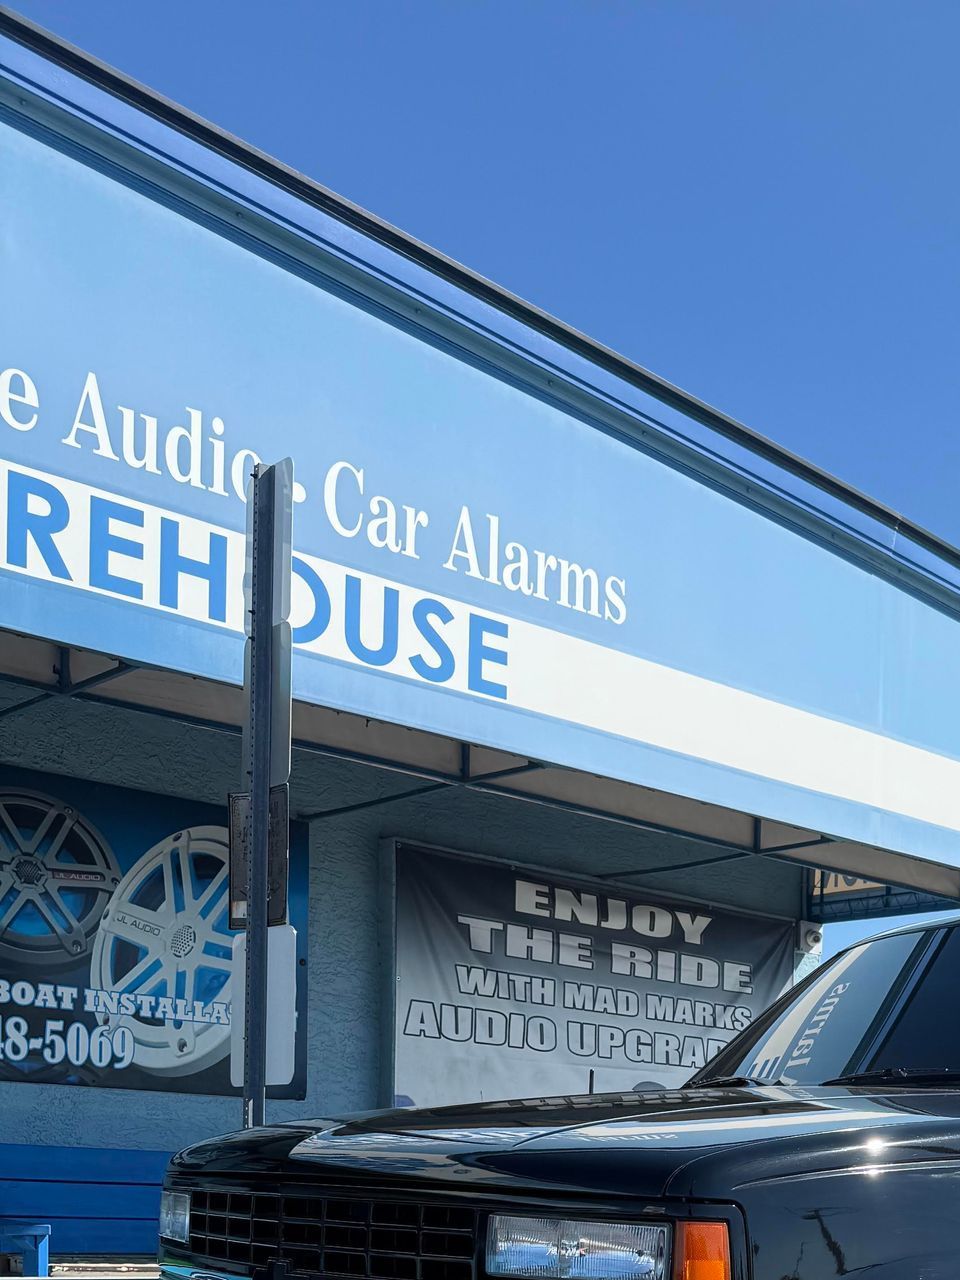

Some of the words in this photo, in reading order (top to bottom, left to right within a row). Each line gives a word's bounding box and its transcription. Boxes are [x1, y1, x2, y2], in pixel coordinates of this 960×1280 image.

[61, 371, 264, 504] Audio
[323, 460, 429, 559] Car
[442, 505, 628, 624] Alarms
[117, 915, 128, 925] JL
[130, 920, 161, 937] AUDIO
[515, 879, 712, 945] ENJOY
[457, 914, 594, 969] THE
[611, 943, 753, 994] RIDE
[84, 988, 232, 1025] INSTALLA
[403, 999, 557, 1052] AUDIO
[455, 965, 556, 1007] WITH
[563, 981, 640, 1018] MAD
[646, 993, 753, 1032] MARKS
[0, 1014, 134, 1069] 8-5069
